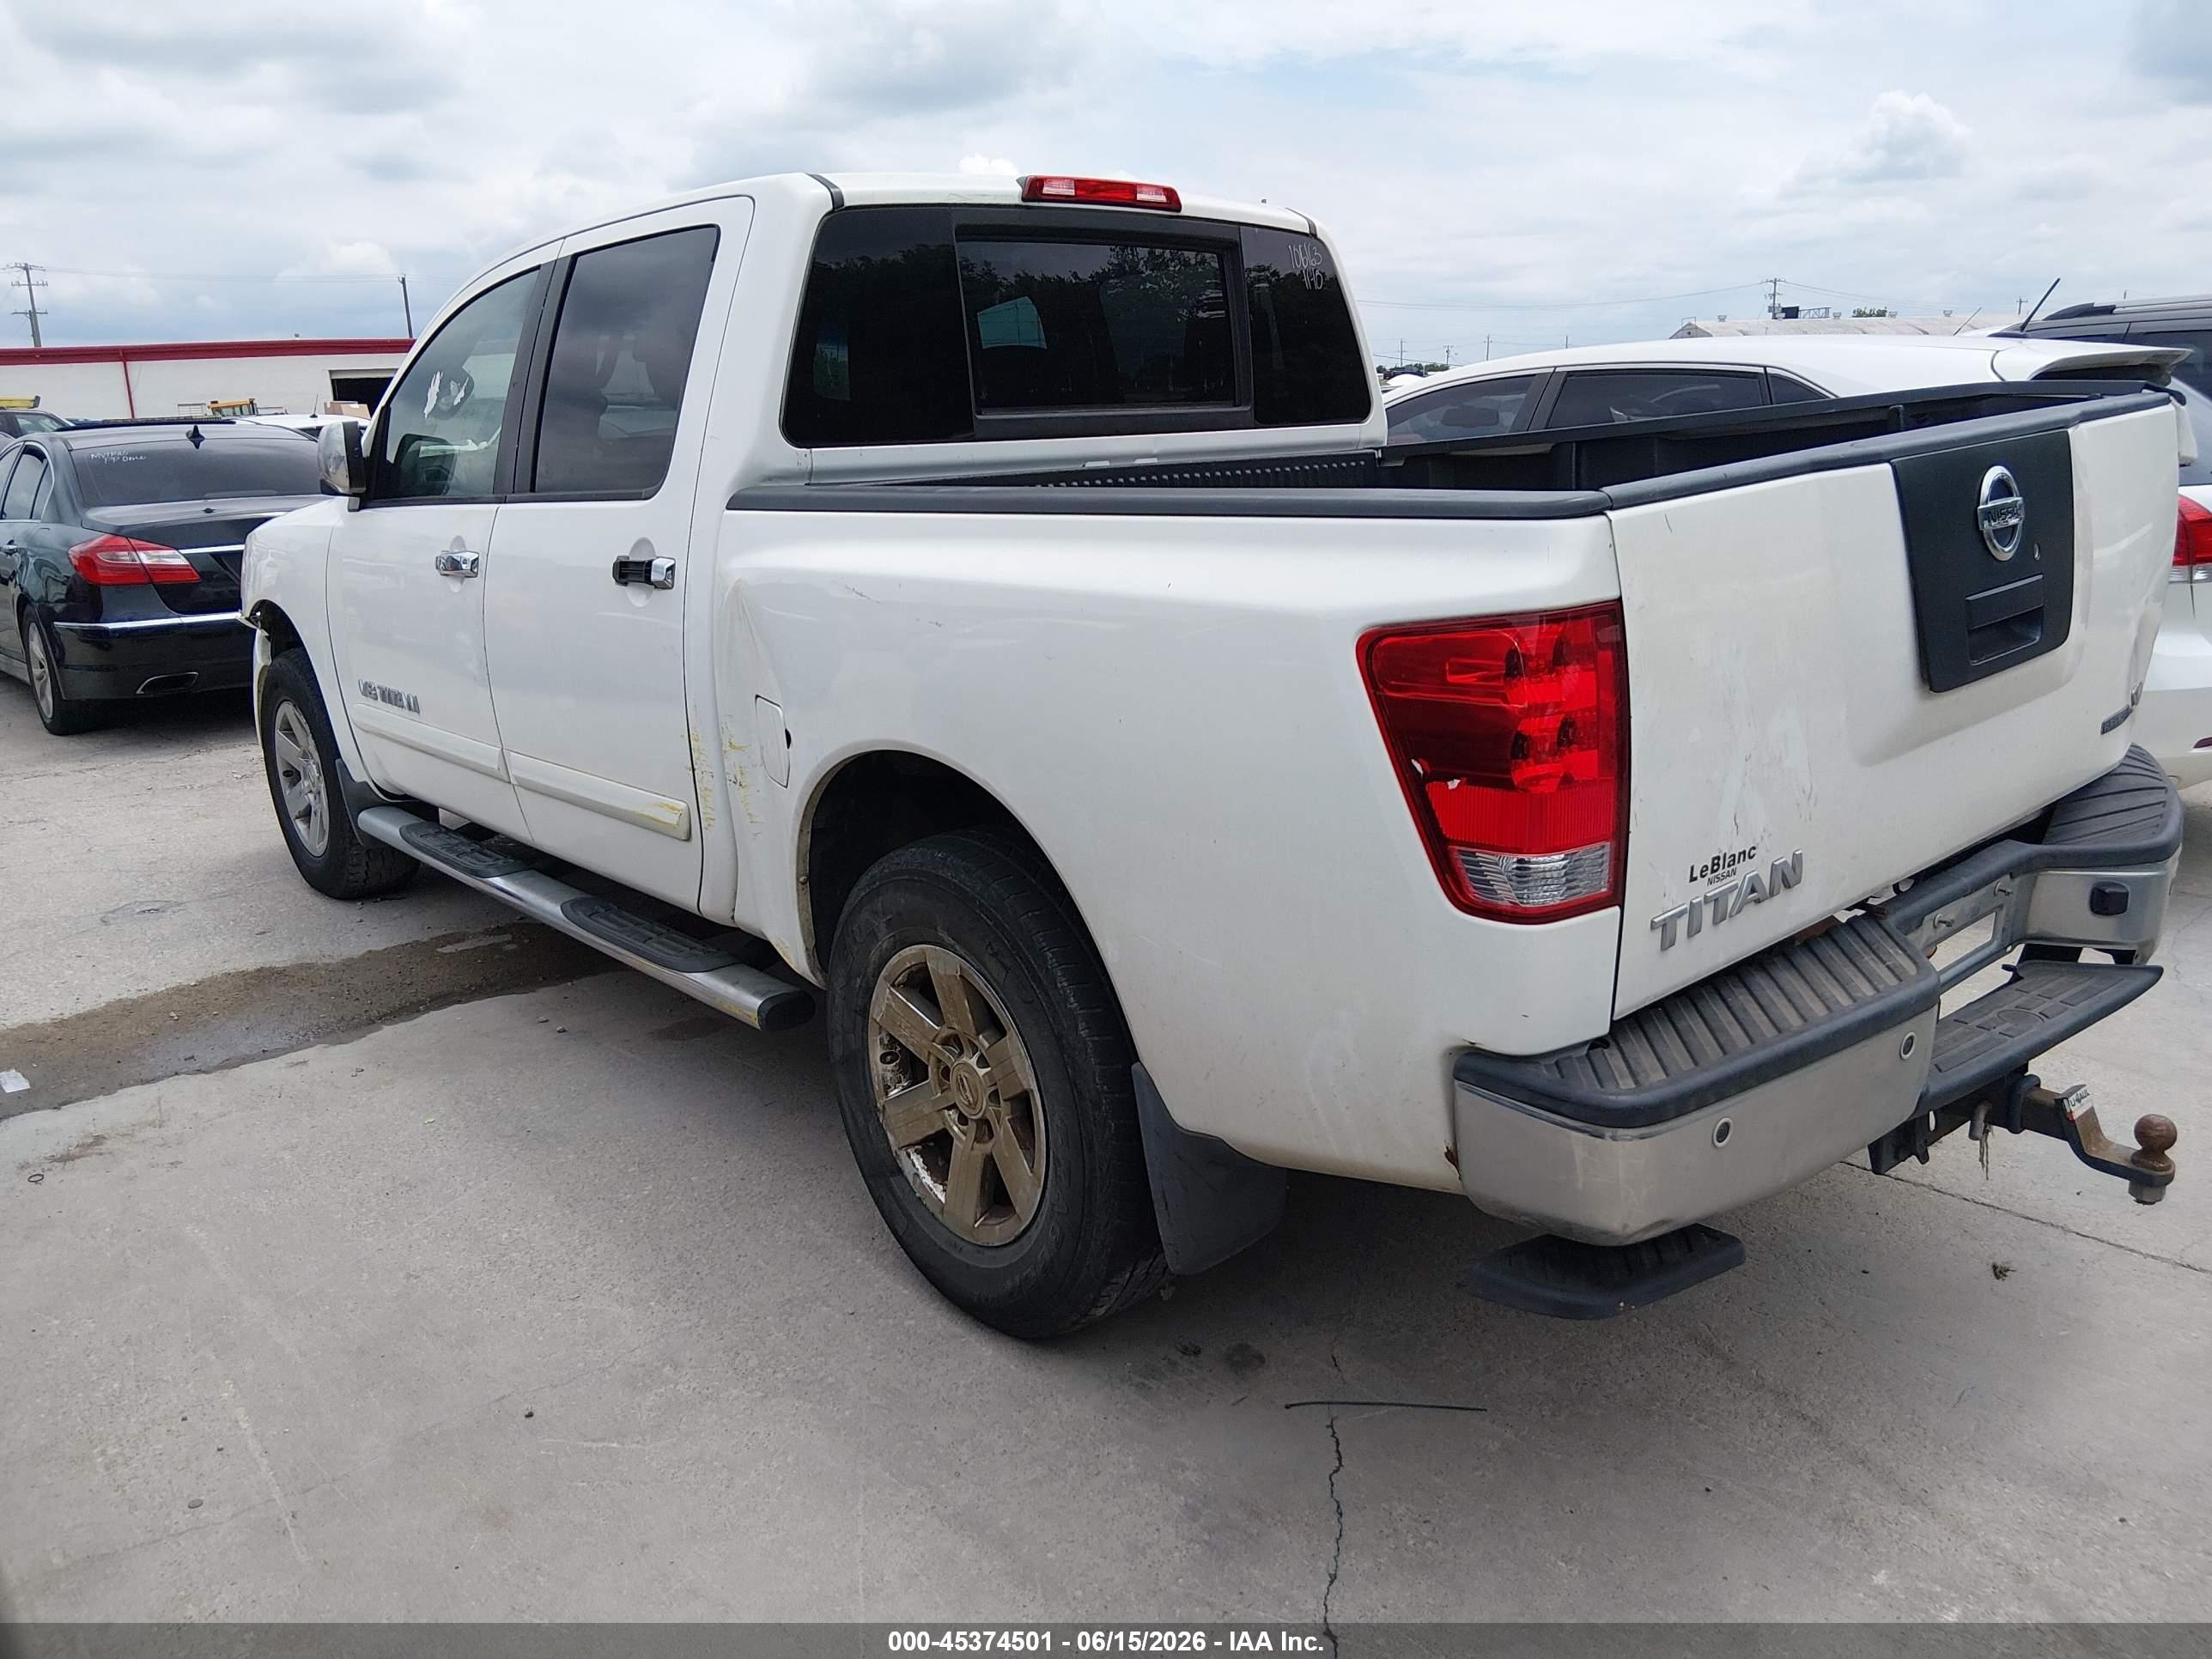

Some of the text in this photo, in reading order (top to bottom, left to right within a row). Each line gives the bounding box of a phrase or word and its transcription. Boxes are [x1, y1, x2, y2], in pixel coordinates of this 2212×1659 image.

[1689, 846, 1757, 883] LeBlanc
[1706, 867, 1737, 886] NISSAN
[1650, 848, 1803, 951] TITAN
